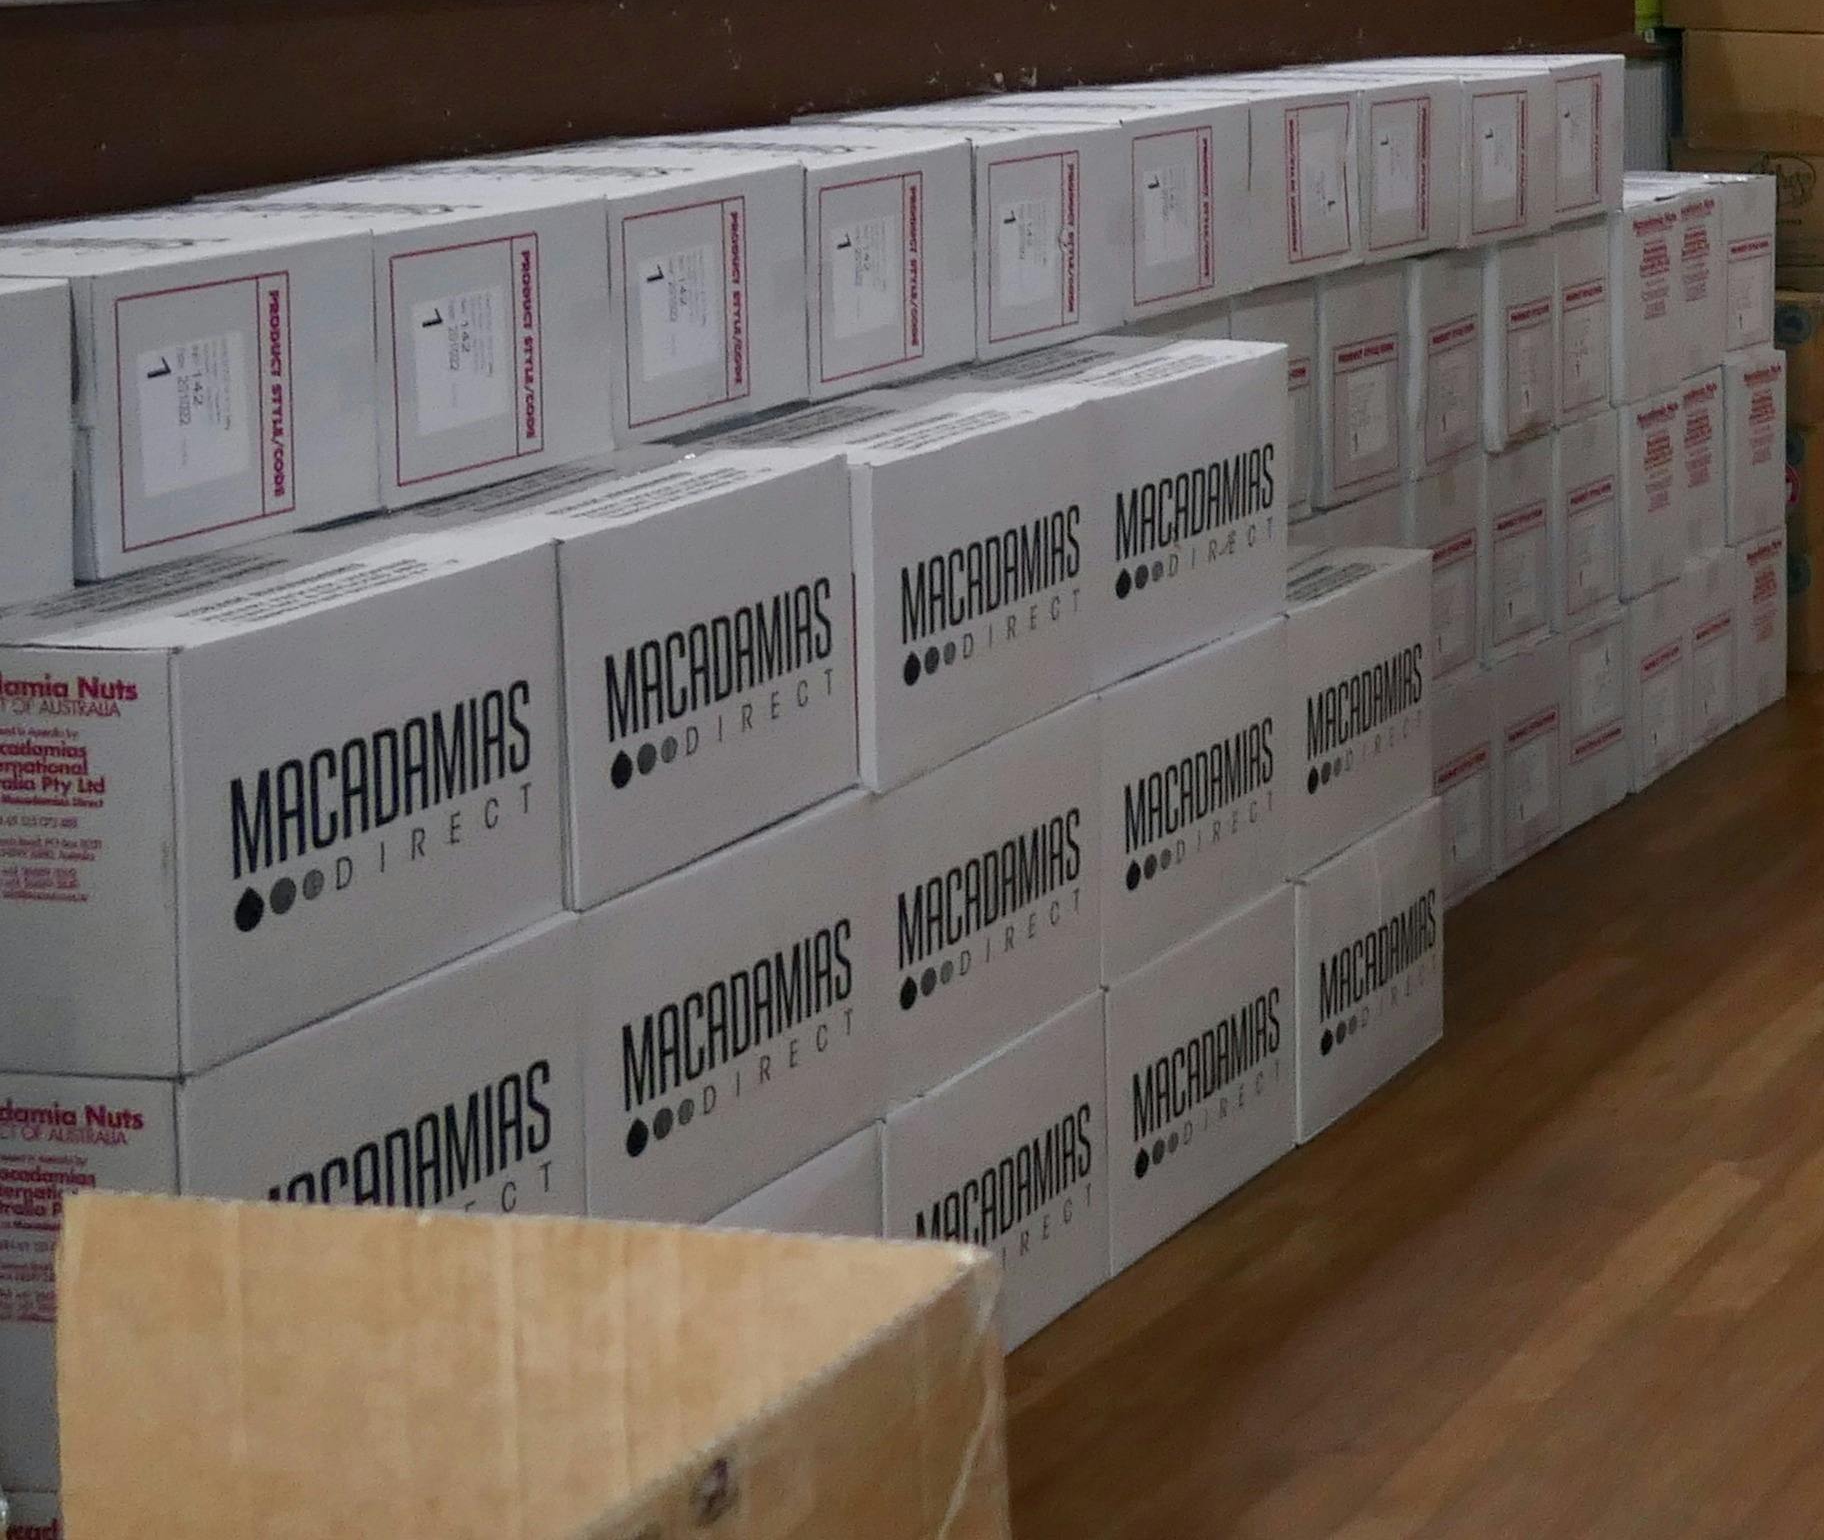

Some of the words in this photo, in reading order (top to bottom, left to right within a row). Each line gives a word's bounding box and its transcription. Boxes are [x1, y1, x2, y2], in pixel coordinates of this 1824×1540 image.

[269, 288, 283, 379] PRODUCT
[1115, 442, 1276, 559] MACADAMIAS
[900, 503, 1082, 645] MACADAMIAS
[961, 587, 1082, 661] DIRECT
[78, 676, 138, 700] Nuts
[604, 577, 834, 744] MACADAMIAS
[685, 666, 835, 758] DIRECT
[1306, 643, 1423, 764] MACADAMIAS
[230, 679, 531, 880] MACADAMIAS
[335, 782, 533, 892] DIRECT
[1125, 716, 1275, 856] MACADAMIAS
[898, 807, 1082, 971] MACADAMIAS
[957, 885, 1082, 977] DIRECT
[622, 917, 853, 1112] MACADAMIAS
[1132, 985, 1280, 1141] MACADAMIAS
